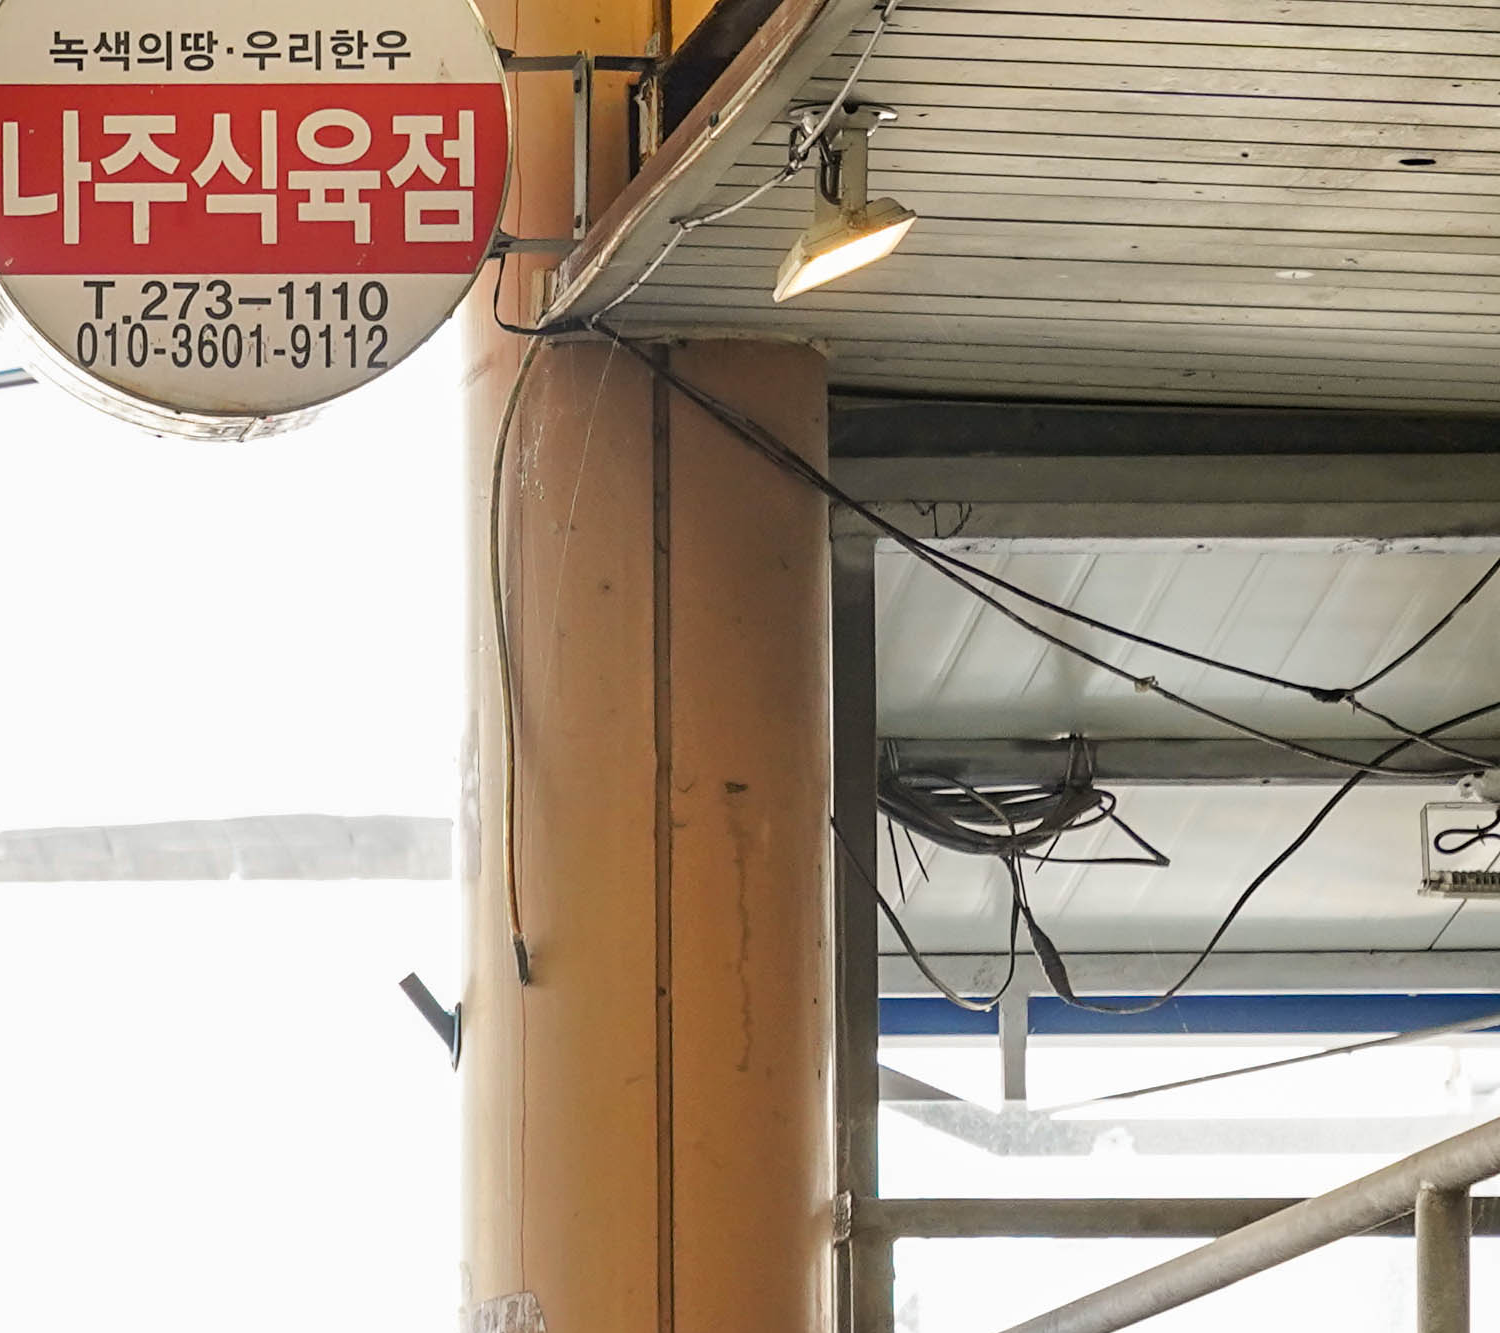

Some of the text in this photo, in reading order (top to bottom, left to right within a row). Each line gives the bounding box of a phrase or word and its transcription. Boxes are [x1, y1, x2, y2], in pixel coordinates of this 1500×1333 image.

[1, 107, 476, 246] 나주식육점
[83, 279, 389, 325] T.273-1110
[76, 322, 389, 370] 010-3601-9112
